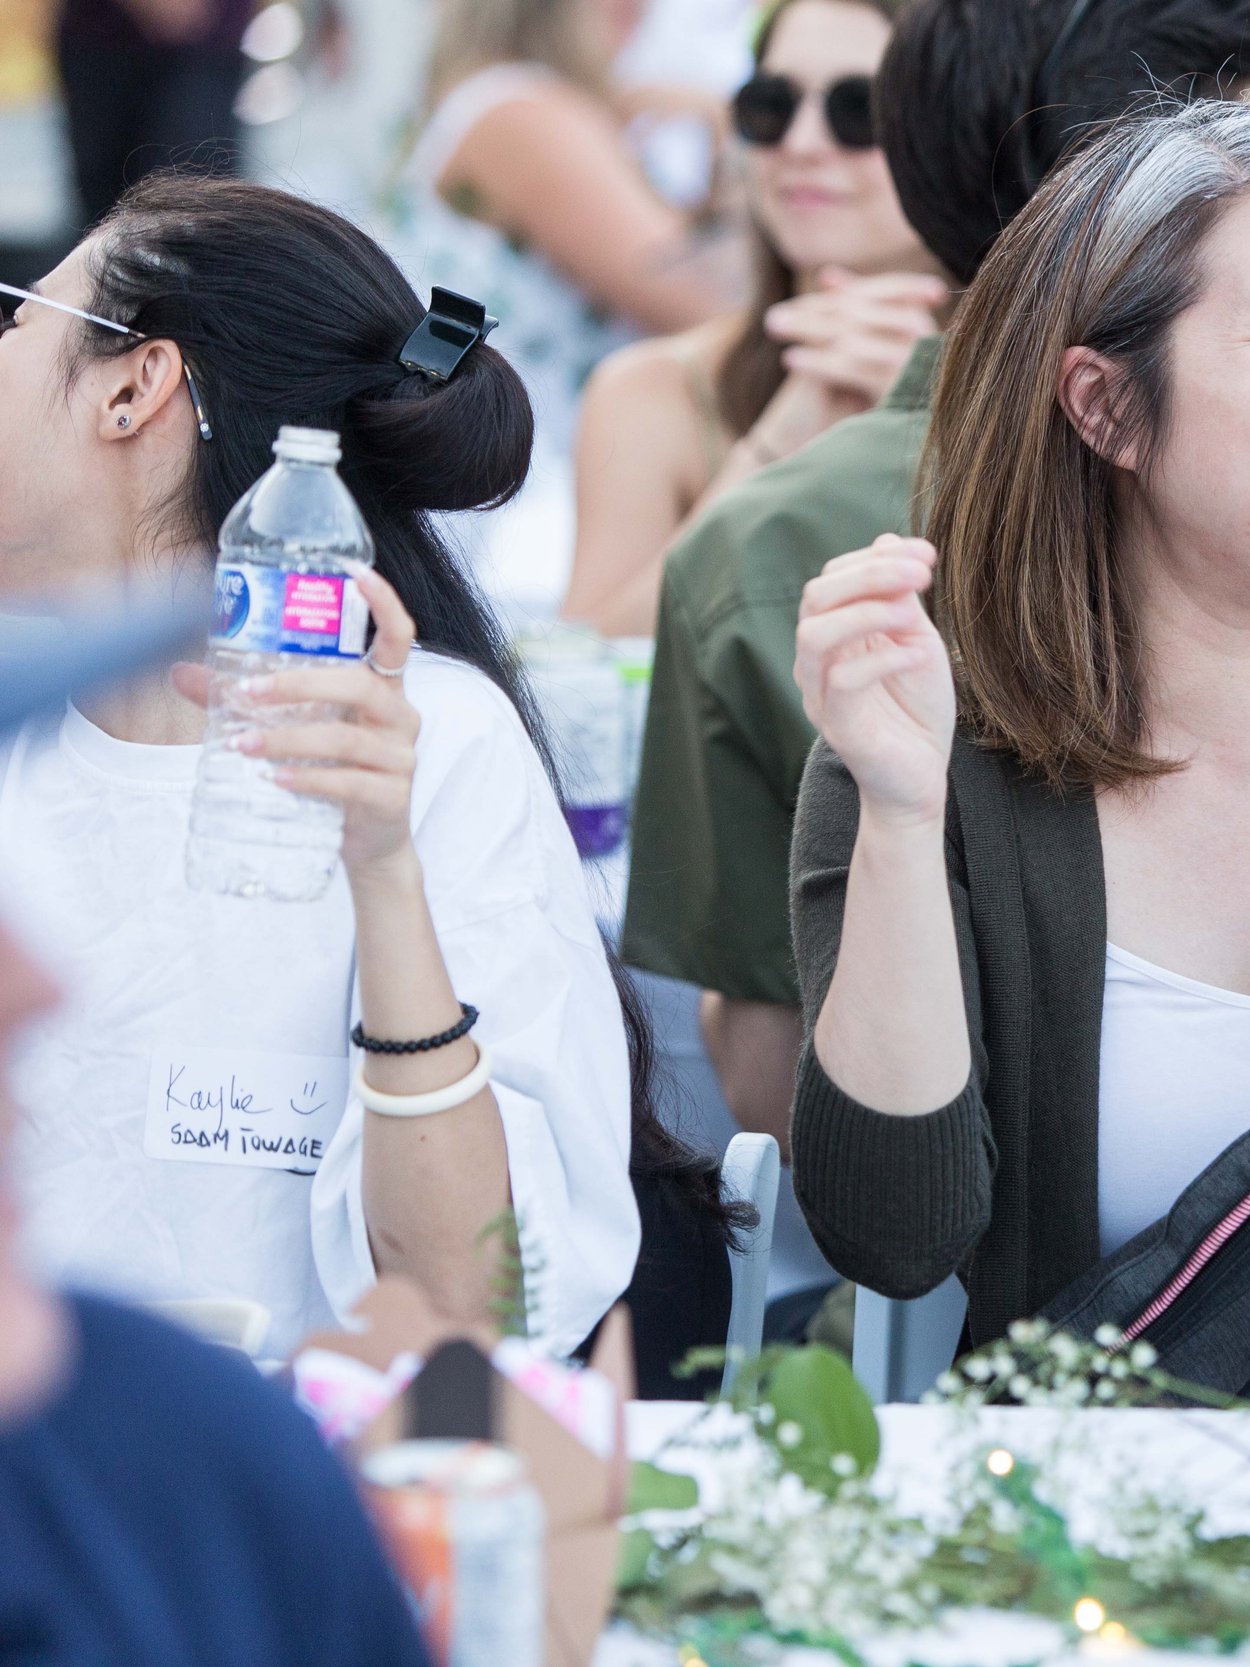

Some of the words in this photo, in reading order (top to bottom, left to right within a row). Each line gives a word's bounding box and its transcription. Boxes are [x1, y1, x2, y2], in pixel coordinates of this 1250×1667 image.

[166, 1063, 273, 1133] Kaylie
[171, 1122, 230, 1151] SAAM
[240, 1127, 324, 1159] TOWAGE
